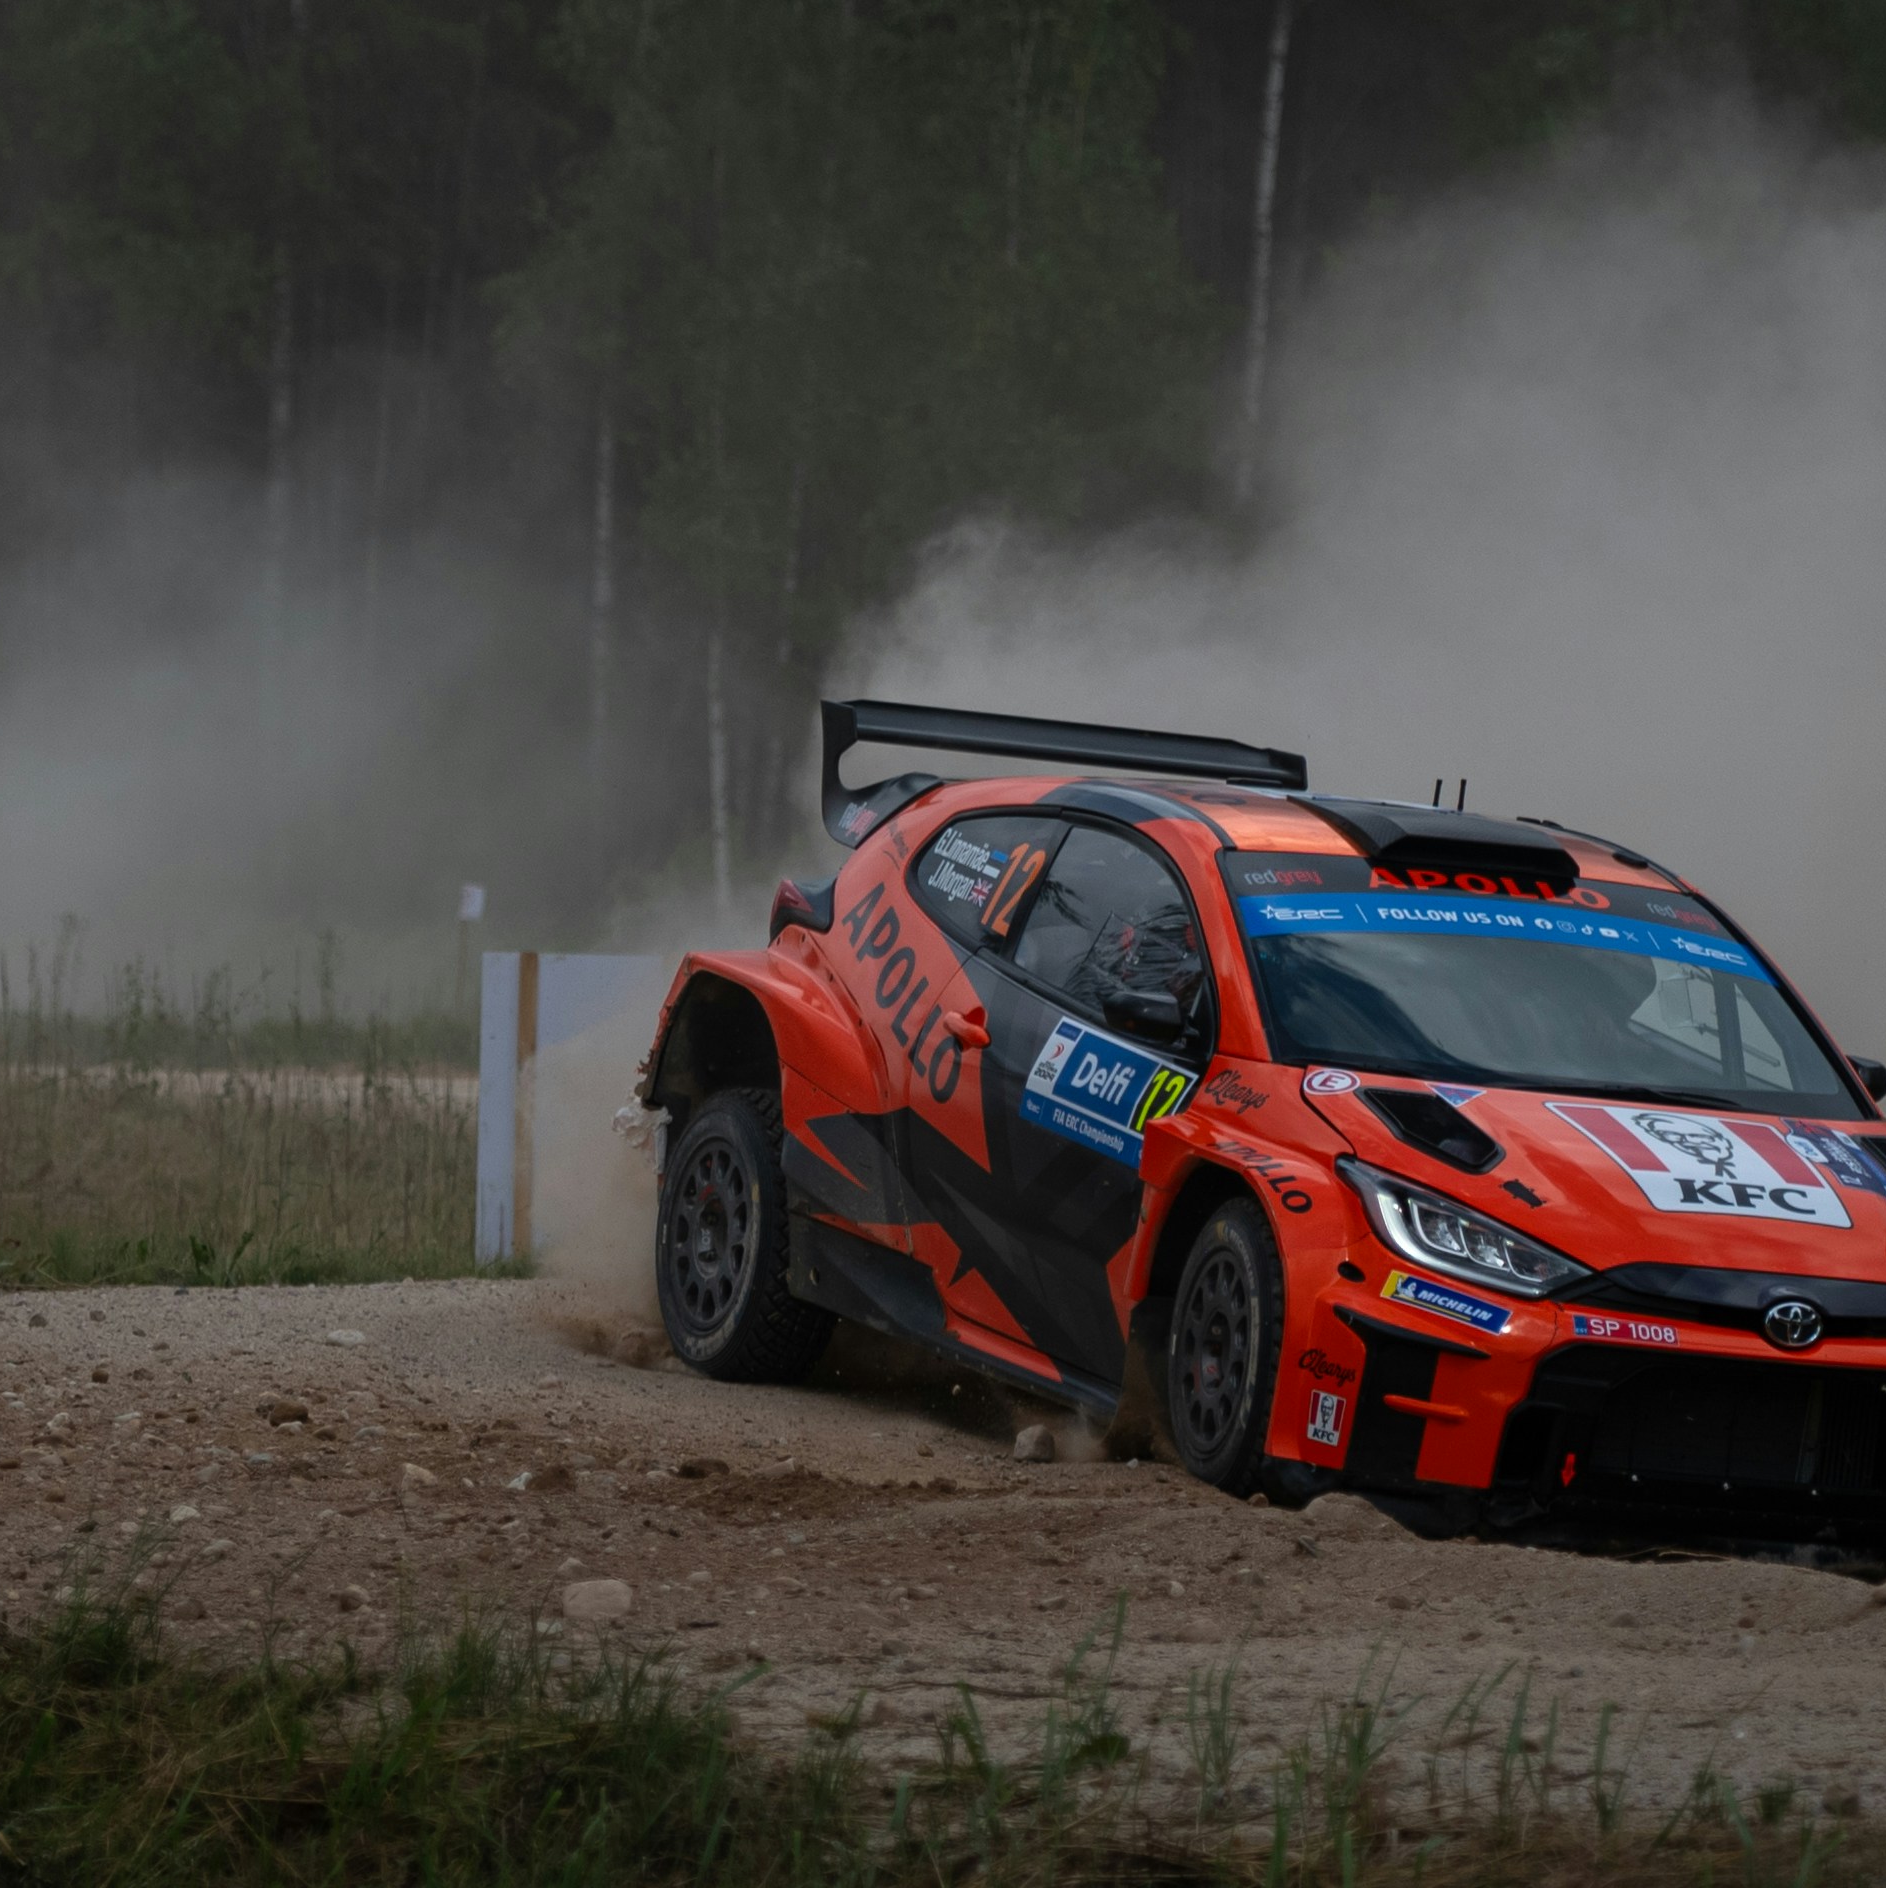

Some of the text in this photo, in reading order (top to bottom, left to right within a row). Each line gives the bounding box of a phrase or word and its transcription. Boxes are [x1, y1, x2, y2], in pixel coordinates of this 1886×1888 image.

[934, 827, 991, 872] G.Linnamäe
[928, 859, 975, 902] J.Morgan
[980, 842, 1047, 937] 12
[1244, 868, 1323, 886] redgrey
[1369, 867, 1611, 910] APOLLO
[1377, 907, 1525, 928] FOLLOW US ON
[841, 882, 963, 1104] APOLLO
[1071, 1052, 1136, 1106] Delfi
[1136, 1070, 1186, 1131] 12
[1052, 1108, 1066, 1124] FIA
[1065, 1113, 1080, 1132] ERC
[1079, 1120, 1125, 1154] Championship
[1673, 1178, 1817, 1215] KFC
[1418, 1289, 1493, 1322] MICHELIN
[1589, 1318, 1676, 1344] SP 1008
[1312, 1427, 1335, 1443] KFC
